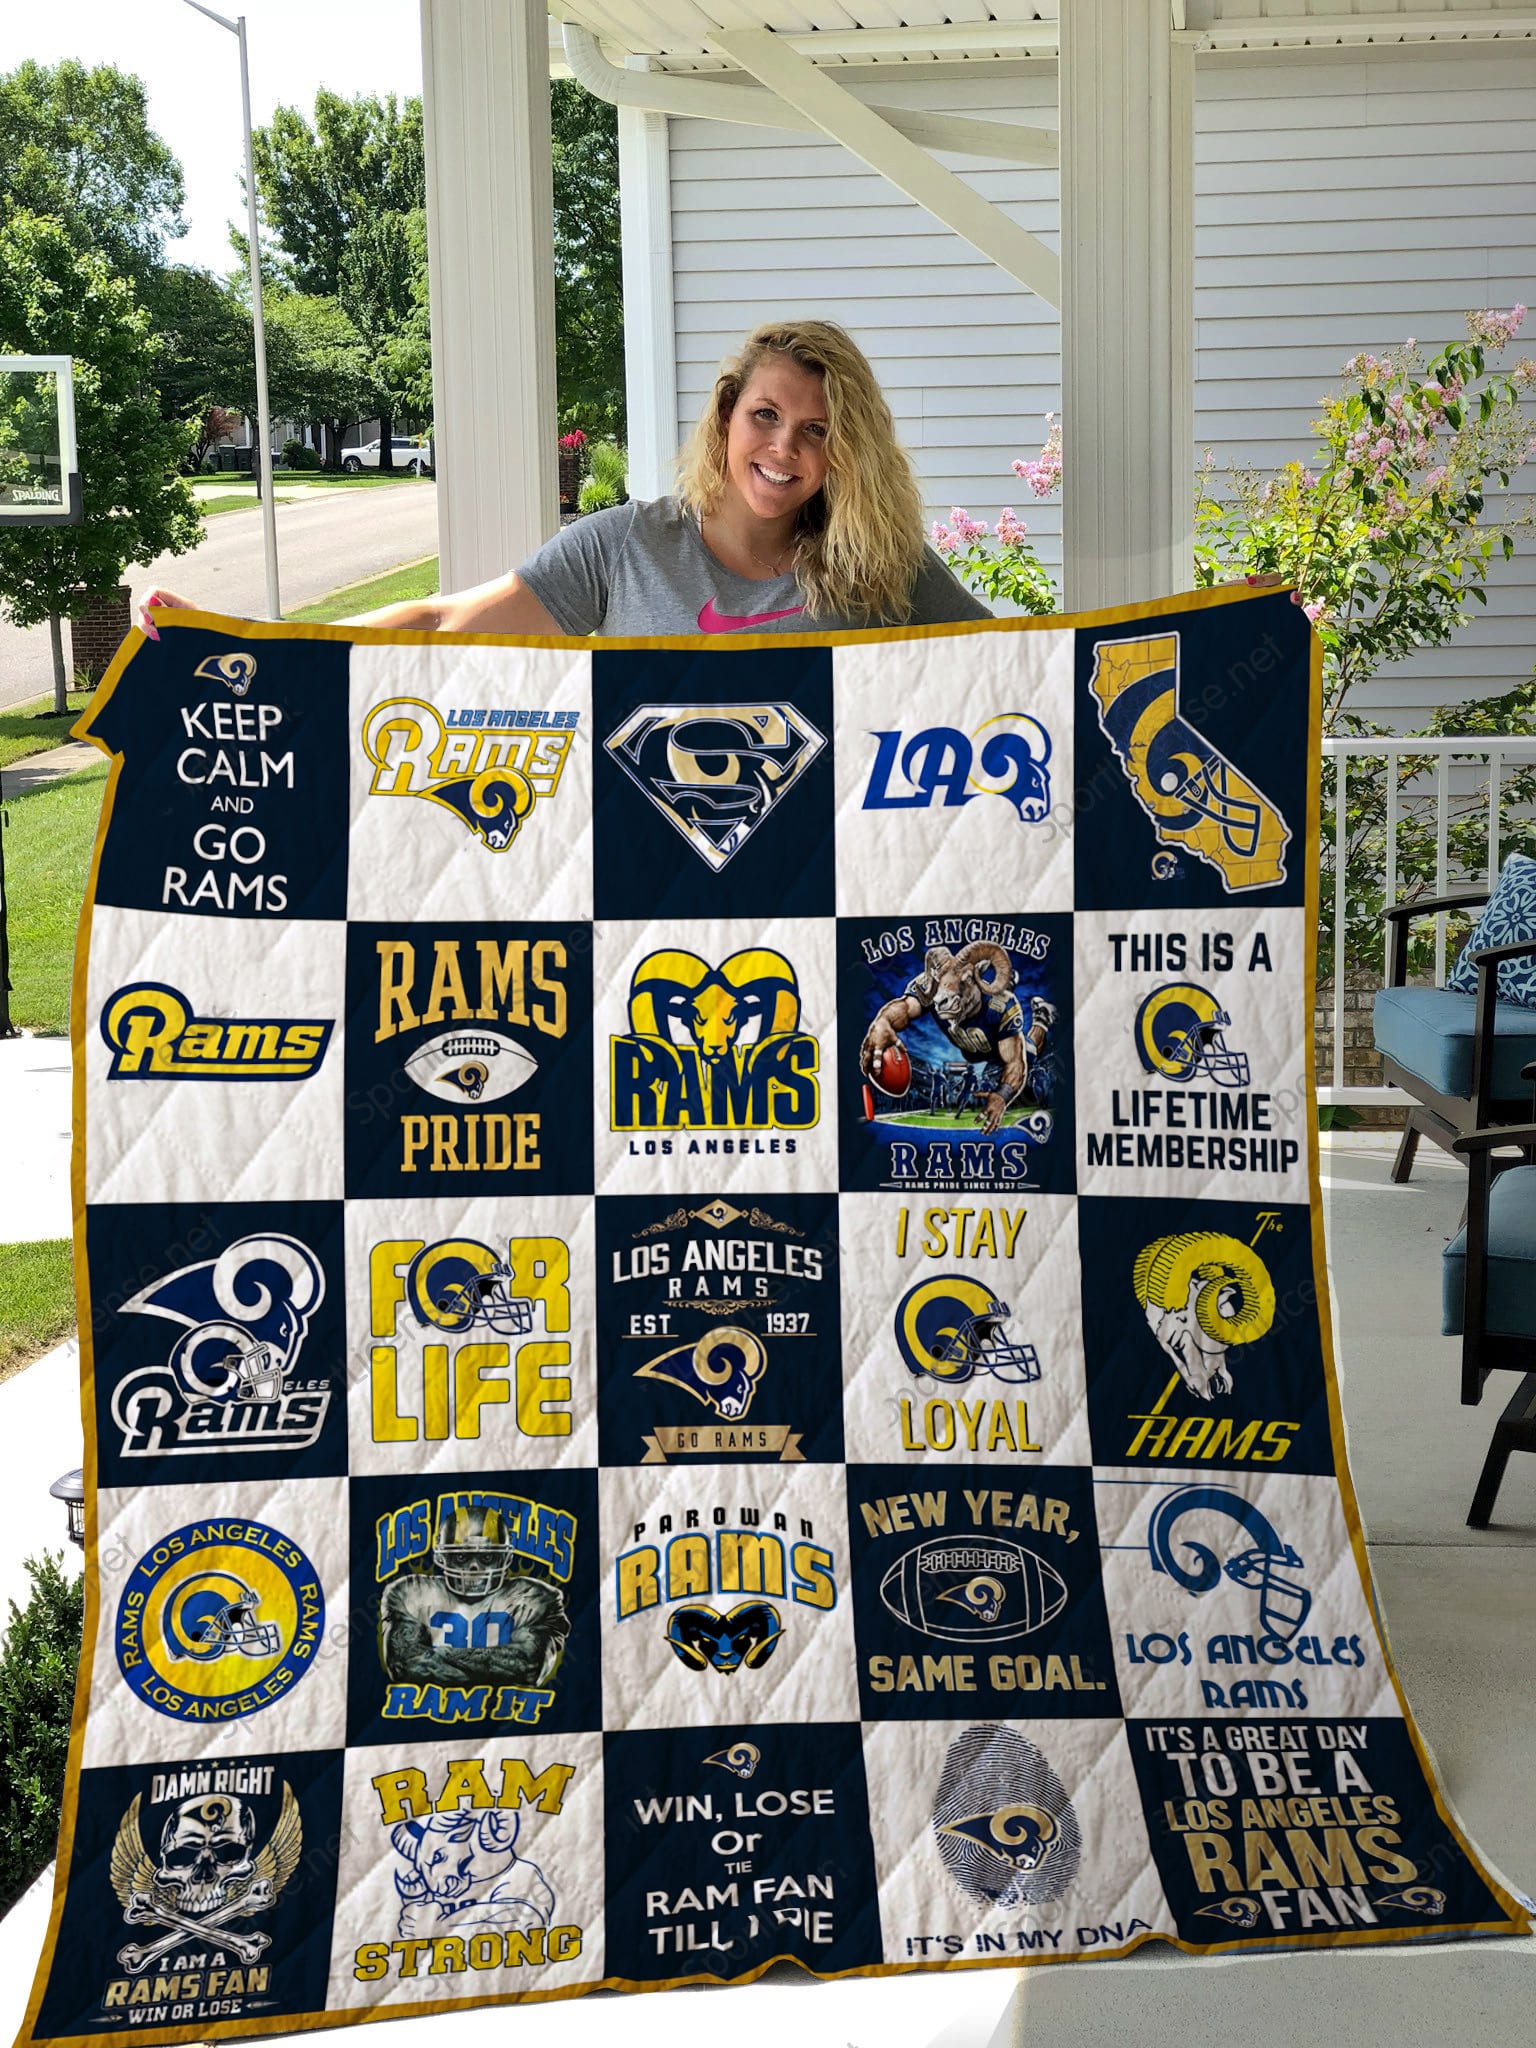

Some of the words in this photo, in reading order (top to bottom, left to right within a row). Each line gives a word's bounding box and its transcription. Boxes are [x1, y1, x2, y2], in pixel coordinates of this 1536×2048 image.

[12, 489, 59, 502] SPALDING
[180, 702, 283, 741] KEEP
[446, 709, 486, 727] LOS
[488, 710, 580, 730] ANGELES
[176, 747, 295, 789] CALM
[210, 795, 255, 815] AND
[193, 823, 266, 865] GO
[161, 866, 288, 912] RAMS
[861, 926, 915, 964] LOS
[925, 918, 1051, 962] ANGELES
[1108, 933, 1187, 972] THIS
[1202, 933, 1234, 972] IS
[1248, 932, 1273, 972] A
[374, 940, 567, 1044] RAMS
[610, 1034, 820, 1132] RAMS
[1112, 1090, 1272, 1132] LIFETIME
[400, 1113, 541, 1173] PRIDE
[630, 1140, 673, 1156] LOS
[688, 1139, 797, 1155] ANGELES
[891, 1143, 1029, 1180] RAMS
[1087, 1132, 1299, 1174] MEMBERSHIP
[896, 1207, 909, 1257] I
[921, 1207, 1027, 1258] STAY
[1250, 1211, 1284, 1247] The
[612, 1242, 671, 1284] LOS
[681, 1239, 823, 1281] ANGELES
[369, 1237, 571, 1337] FR
[668, 1275, 769, 1299] RAMS
[630, 1314, 671, 1335] EST
[766, 1312, 810, 1334] 1937
[370, 1341, 572, 1442] LIFE
[677, 1432, 698, 1449] GO
[715, 1431, 767, 1448] RAMS
[900, 1398, 1042, 1452] LOYAL
[1125, 1414, 1301, 1462] RAMS
[634, 1506, 813, 1543] PAROWAN
[859, 1490, 947, 1539] NEW
[962, 1490, 1081, 1544] YEAR,
[376, 1499, 432, 1583] LOS
[139, 1536, 186, 1578] LOS
[190, 1524, 303, 1569] ANGELES
[292, 1582, 321, 1660] RAMS
[616, 1529, 838, 1623] RAMS
[122, 1590, 144, 1668] RAMS
[1126, 1631, 1192, 1666] LOS
[141, 1675, 185, 1712] LOS
[183, 1666, 295, 1720] ANGELES
[868, 1654, 977, 1692] SAME
[988, 1654, 1107, 1692] GOAL.
[1200, 1678, 1308, 1710] RAMS
[382, 1683, 493, 1724] RAM
[491, 1685, 555, 1724] IT
[1145, 1726, 1196, 1752] IT'S
[1202, 1726, 1223, 1751] A
[1226, 1725, 1310, 1751] GREAT
[1316, 1725, 1369, 1750] DAY
[150, 1769, 213, 1804] DAMN
[214, 1765, 275, 1795] RIGHT
[371, 1759, 576, 1826] RAM
[1167, 1751, 1239, 1798] TO
[1246, 1750, 1321, 1797] BE
[1334, 1750, 1374, 1795] A
[633, 1794, 723, 1825] WIN,
[734, 1789, 836, 1817] LOSE
[1163, 1799, 1233, 1832] LOS
[1241, 1795, 1402, 1829] ANGELES
[711, 1830, 763, 1856] Or
[1183, 1827, 1419, 1894] RAMS
[724, 1860, 753, 1875] TIE
[646, 1882, 740, 1918] RAM
[753, 1874, 835, 1904] FAN
[1260, 1886, 1380, 1931] FAN
[354, 1924, 583, 1982] STRONG
[648, 1921, 734, 1955] TILL
[906, 1935, 964, 1957] IT'S
[976, 1933, 1006, 1952] IN
[1017, 1929, 1063, 1950] MY
[1076, 1918, 1153, 1947] DNA
[159, 1956, 169, 1972] I
[173, 1954, 206, 1970] AM
[210, 1952, 226, 1967] A
[103, 1973, 201, 2008] RAMS
[206, 1966, 270, 1997] FAN
[128, 2005, 167, 2024] WIN
[171, 2003, 194, 2018] OR
[198, 1999, 243, 2016] LOSE
